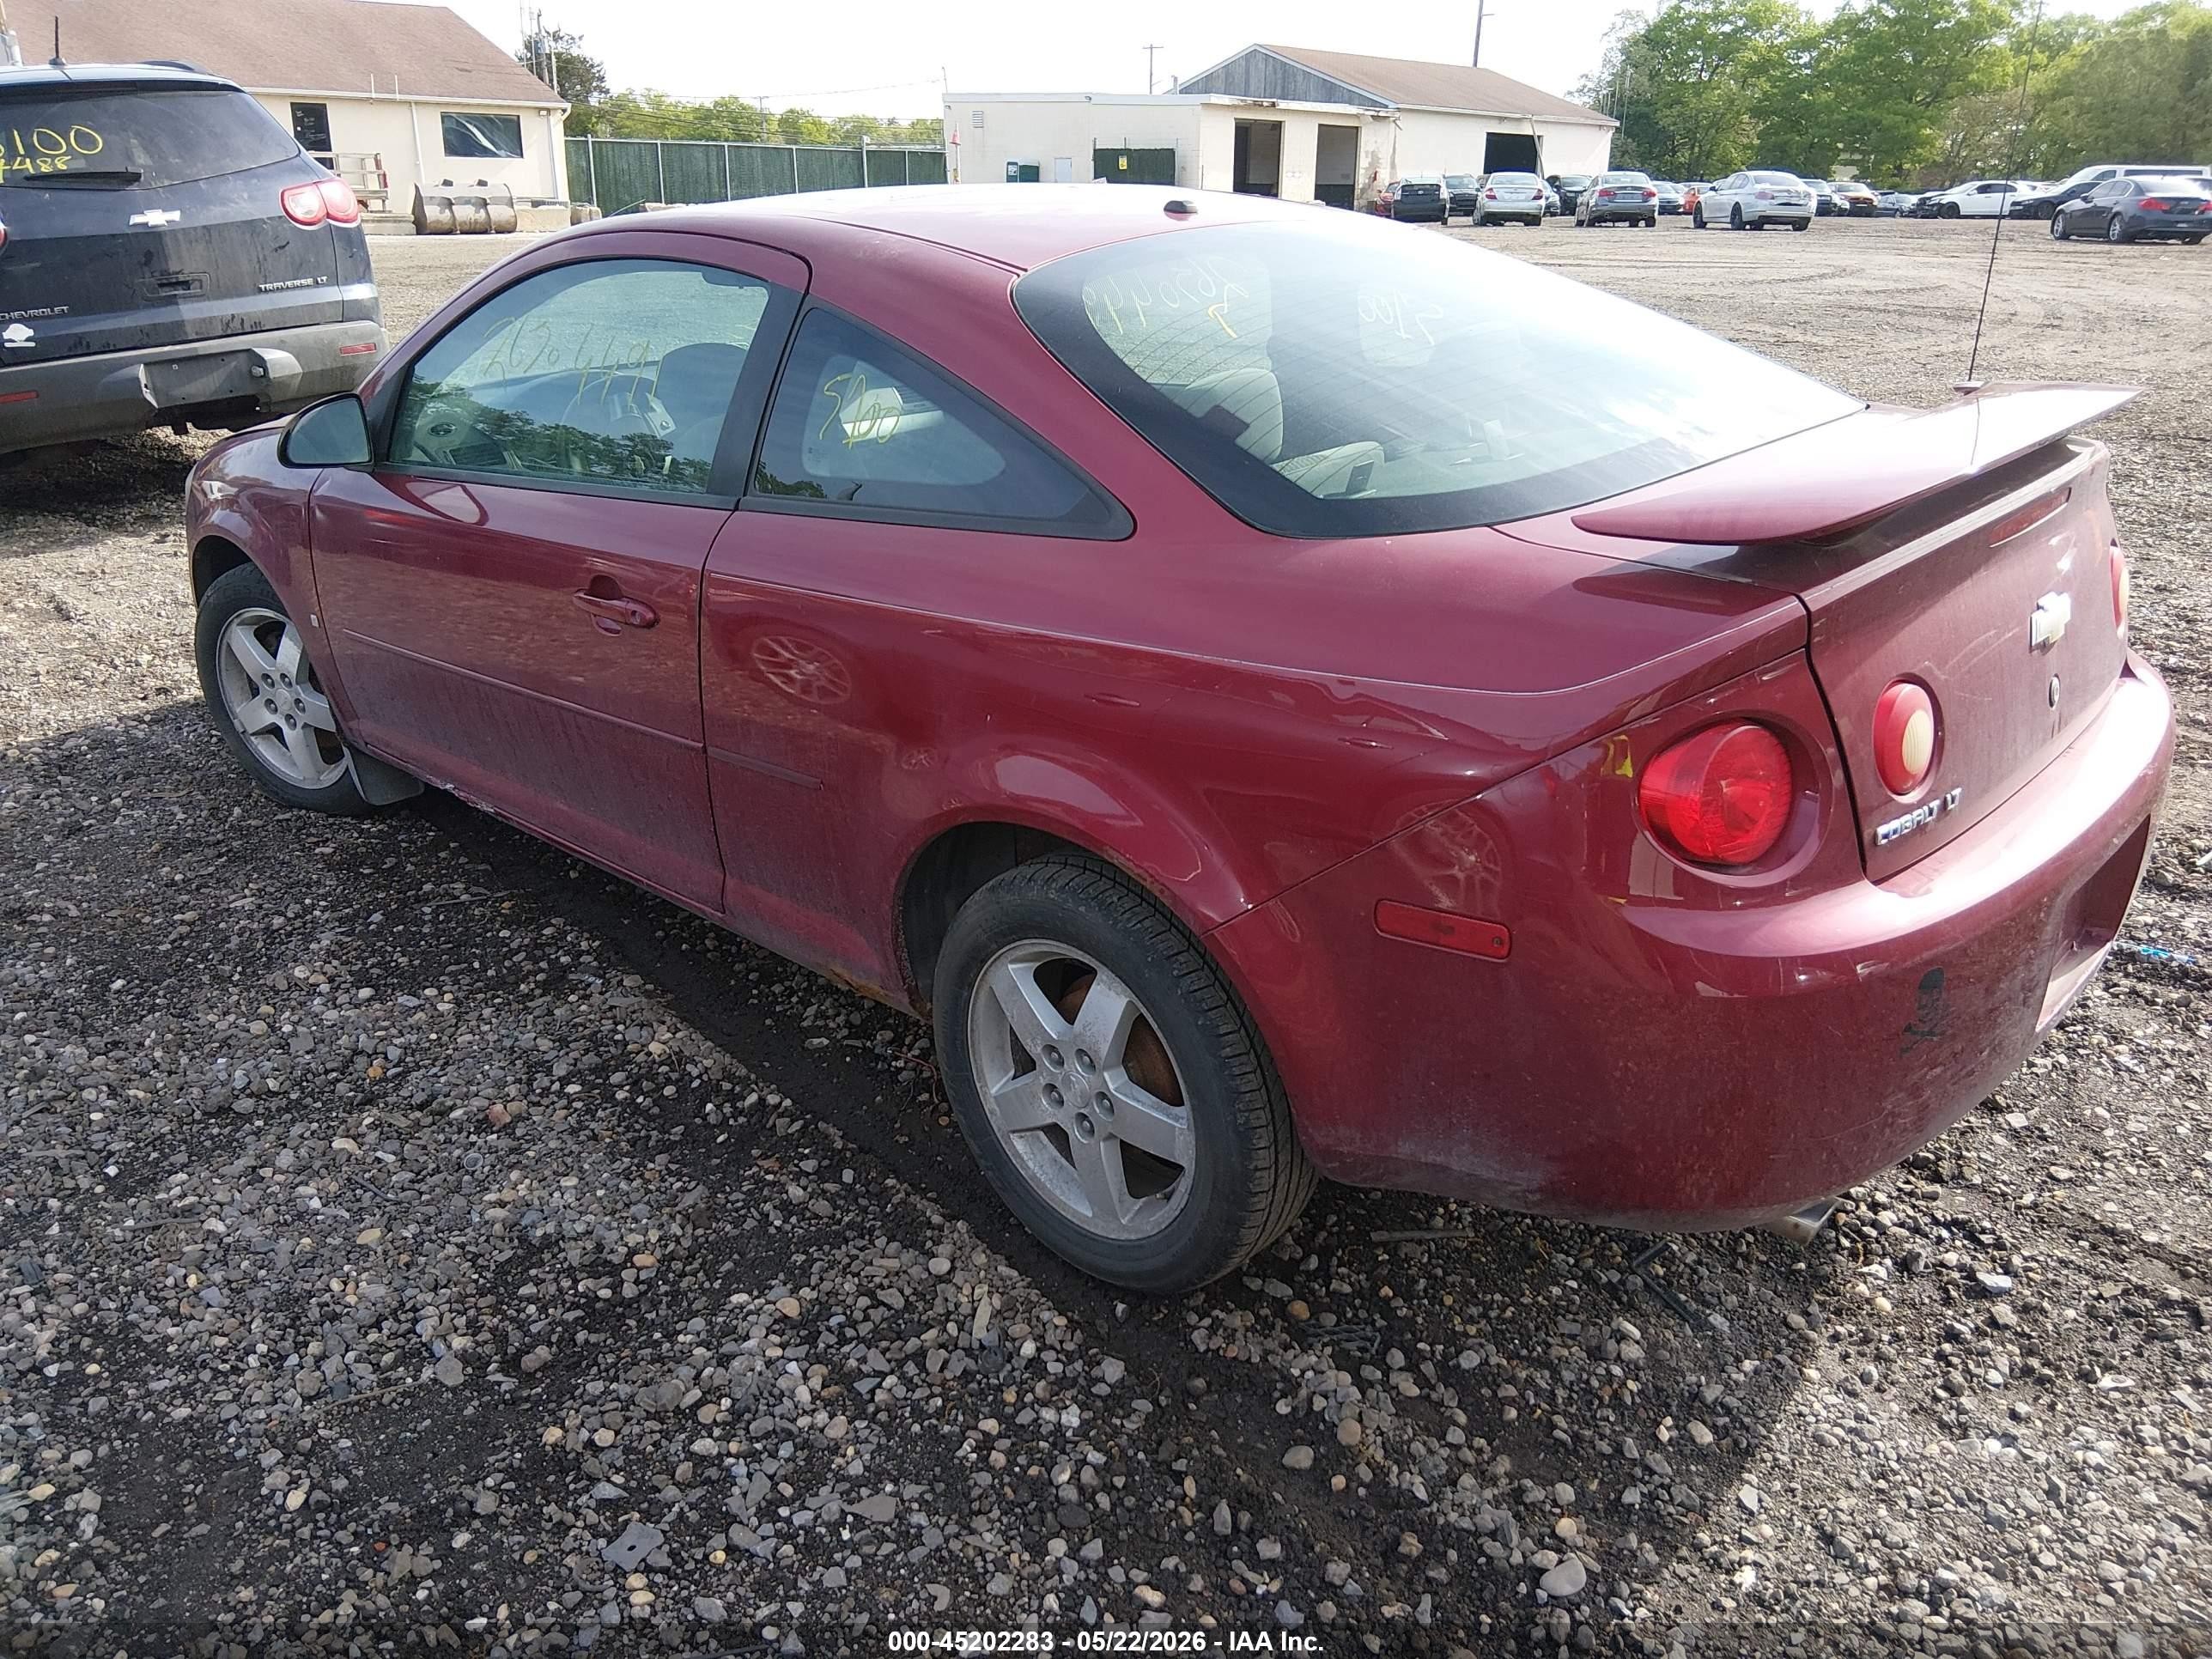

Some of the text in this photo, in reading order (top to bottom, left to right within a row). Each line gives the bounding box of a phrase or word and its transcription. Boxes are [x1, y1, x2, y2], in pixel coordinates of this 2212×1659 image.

[0, 125, 103, 156] 100
[258, 276, 328, 292] TRAVERSE LT
[0, 305, 70, 321] CHEVROLET
[1875, 787, 1963, 846] COBALT LT
